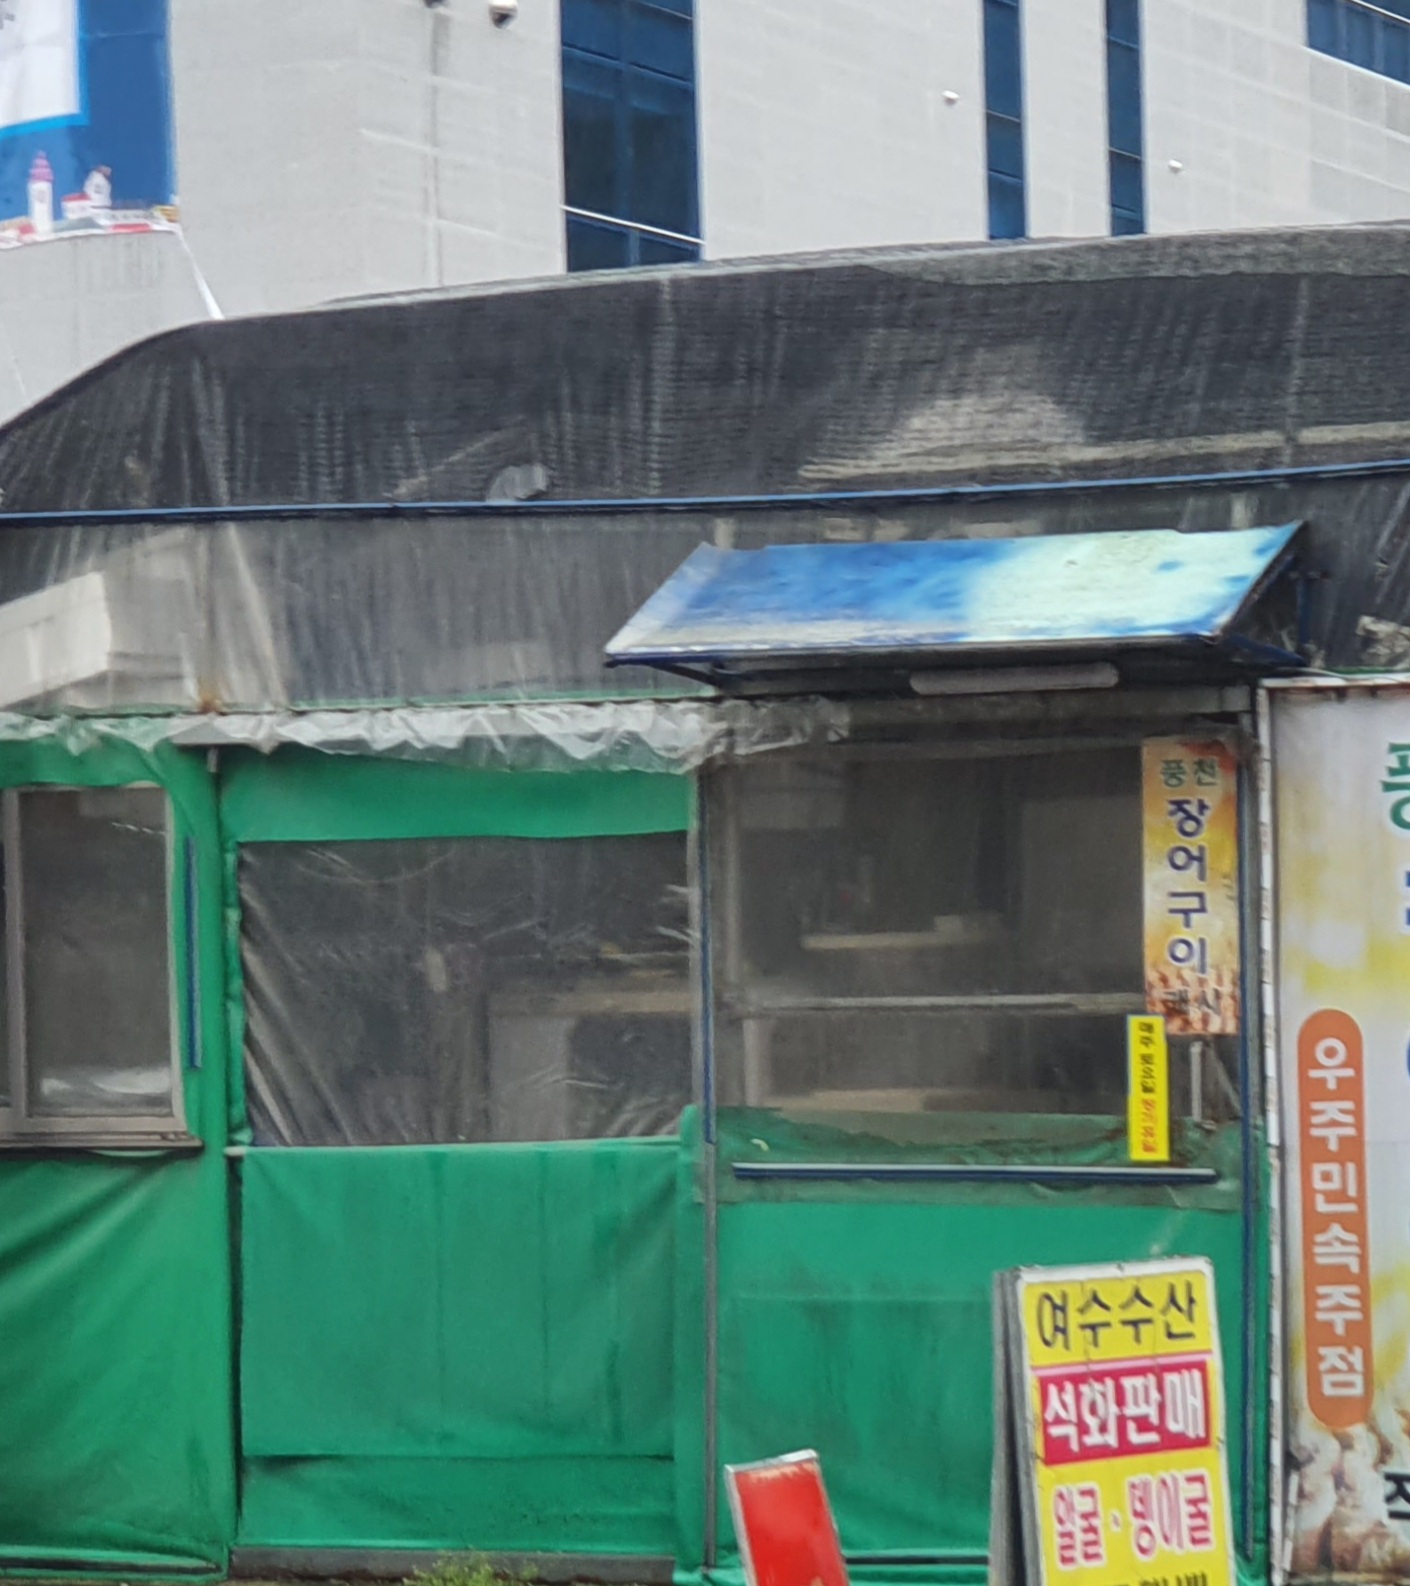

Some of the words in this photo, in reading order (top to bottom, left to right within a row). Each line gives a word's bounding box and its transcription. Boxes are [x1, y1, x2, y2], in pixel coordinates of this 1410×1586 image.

[1161, 759, 1220, 788] 풍천
[1167, 799, 1209, 975] 장어구이
[1308, 1038, 1366, 1398] 우주민속주점
[1037, 1279, 1198, 1350] 여수수산
[1044, 1368, 1207, 1453] 석화판매
